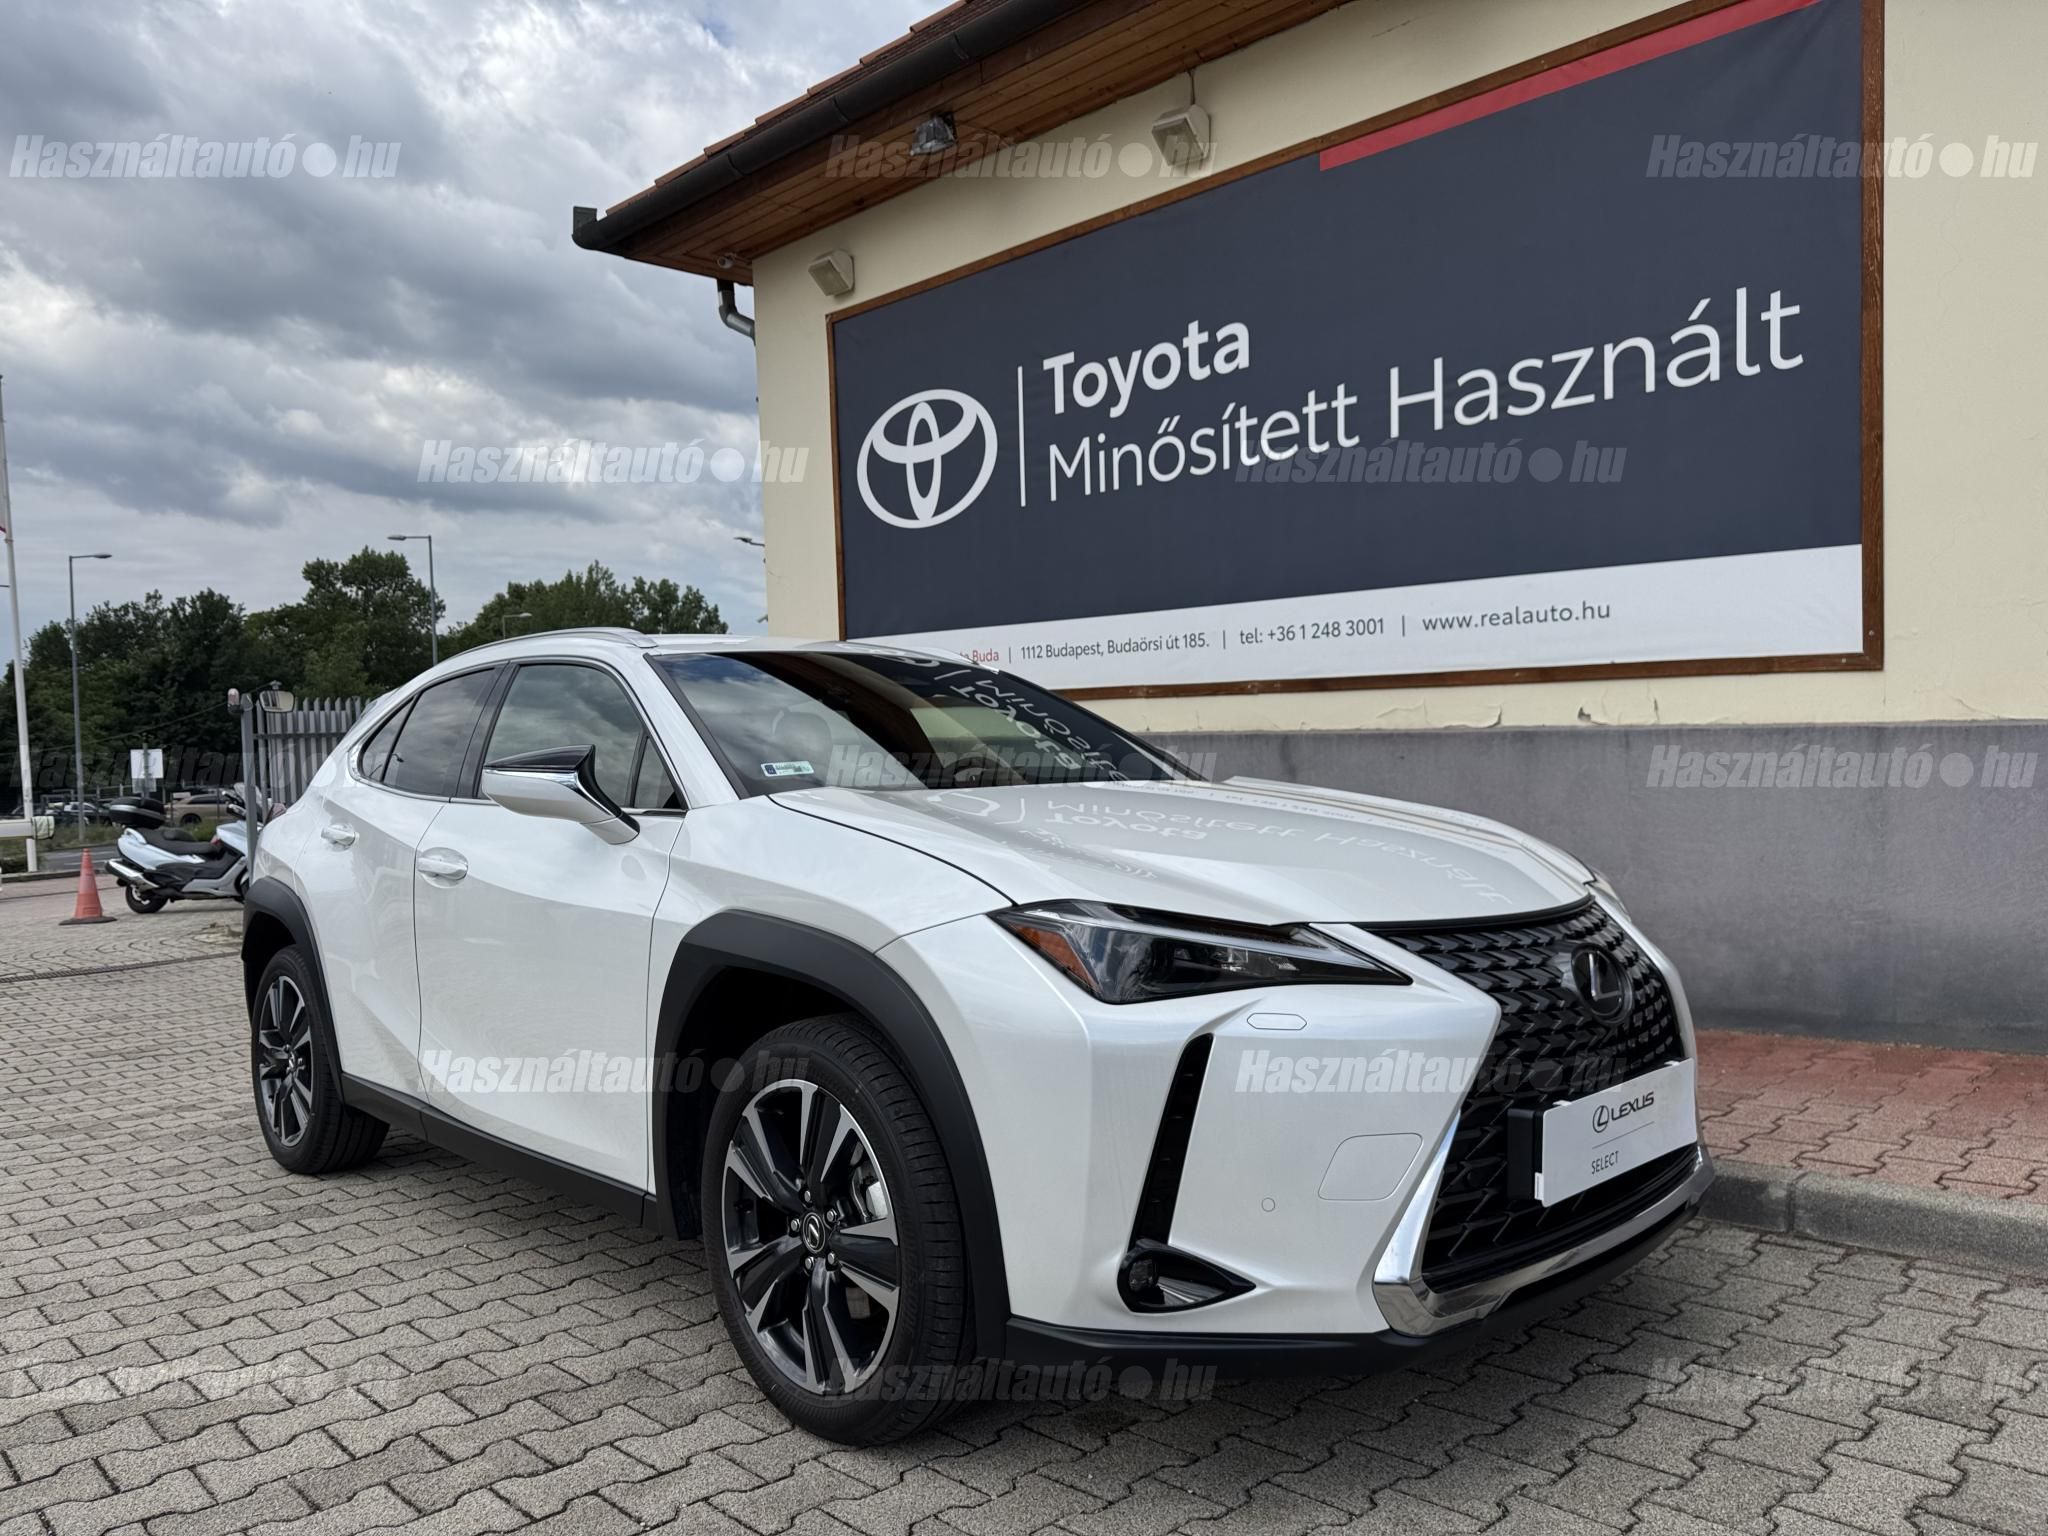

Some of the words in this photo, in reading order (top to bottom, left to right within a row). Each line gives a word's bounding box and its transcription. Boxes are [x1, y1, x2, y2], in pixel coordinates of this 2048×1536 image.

[1043, 319, 1250, 418] Toyota
[1048, 382, 1360, 501] Minősített
[1389, 287, 1803, 439] Használt
[972, 648, 1000, 663] Buda
[1021, 645, 1044, 660] 1112
[1046, 639, 1104, 660] Budapest,
[1107, 635, 1163, 655] Budaörsi
[1166, 634, 1180, 650] út
[1183, 632, 1210, 649] 185.
[1239, 629, 1263, 645] tel:
[1268, 626, 1295, 643] +36
[1300, 625, 1307, 641] 1
[1311, 622, 1342, 640] 248
[1346, 618, 1384, 636] 3001
[1422, 601, 1611, 632] www.realauto.hu
[1611, 1091, 1655, 1121] LEXUS
[1591, 1150, 1620, 1175] SELECT
